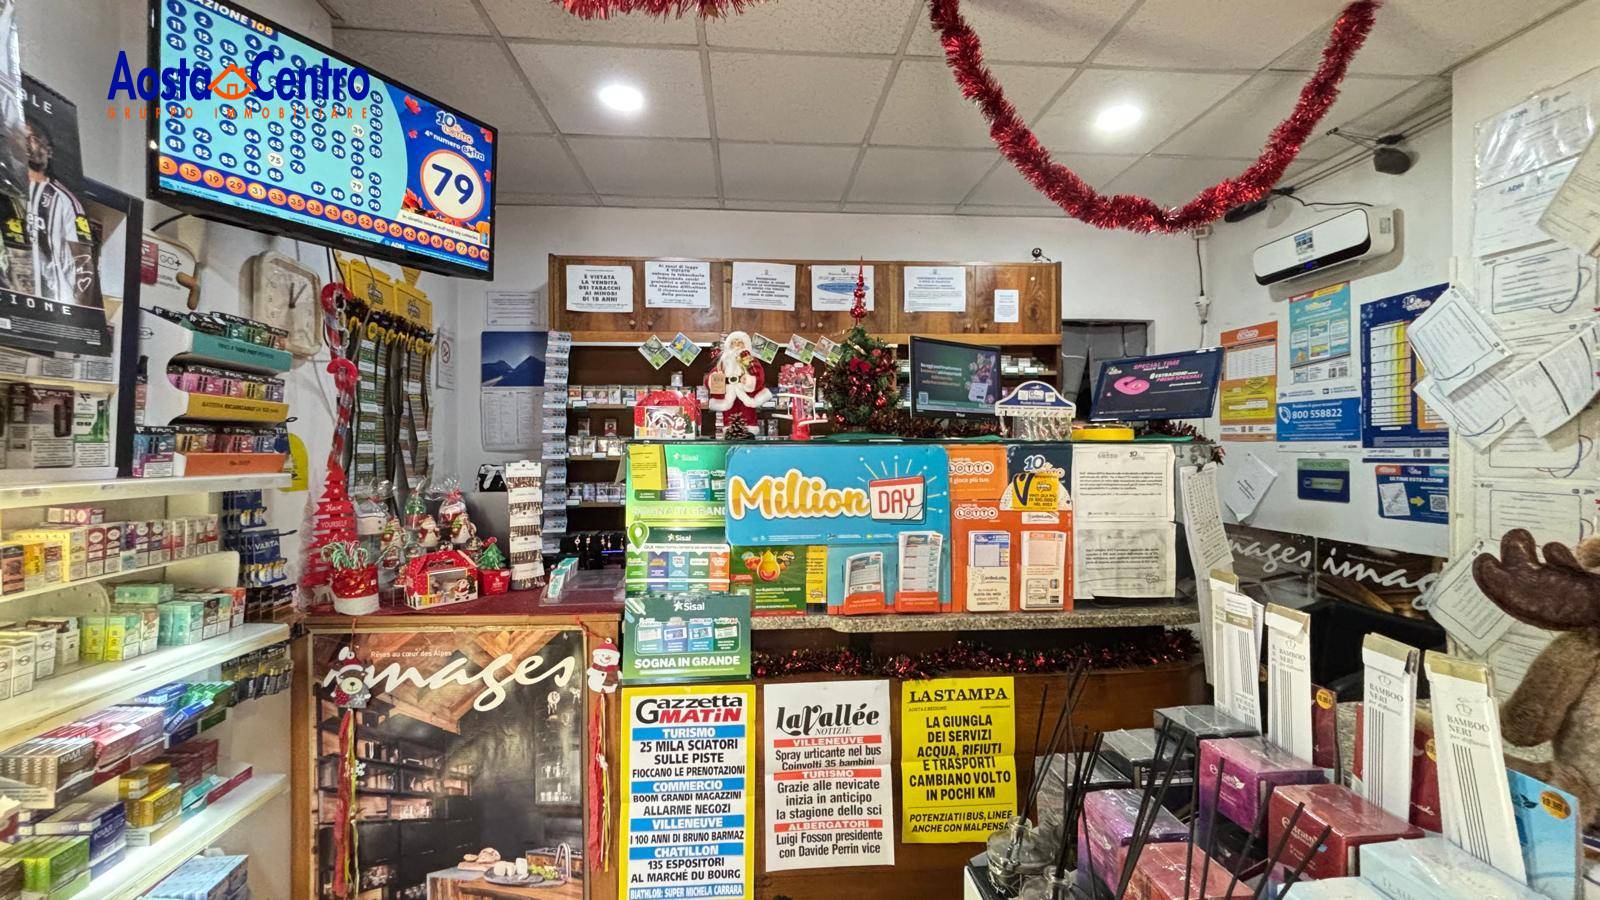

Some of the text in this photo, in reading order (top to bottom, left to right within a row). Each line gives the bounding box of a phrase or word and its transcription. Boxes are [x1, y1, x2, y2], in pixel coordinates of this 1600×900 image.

[201, 0, 273, 35] ZIONE 109
[170, 38, 209, 58] 21 22
[198, 32, 209, 41] 12
[224, 43, 234, 51] 13
[434, 134, 460, 149] numero
[169, 140, 235, 165] 81 82 83
[185, 168, 196, 176] 15
[209, 174, 219, 183] 19
[230, 181, 242, 190] 29
[252, 187, 263, 195] 31
[432, 163, 474, 204] 79
[1292, 409, 1342, 419] 800 558822
[729, 470, 871, 518] Million
[878, 488, 914, 513] DAY
[955, 507, 998, 519] LOTTO
[321, 520, 347, 528] YOURSELF
[255, 541, 279, 550] VARTA
[684, 603, 704, 611] Sisal
[635, 656, 740, 668] SOGNA IN GRANDE
[910, 688, 1007, 702] LA STAMPA
[1369, 683, 1403, 702] BAMBOO
[1369, 692, 1388, 704] NERI
[636, 695, 742, 723] Gazzetta
[926, 715, 992, 728] LA GIUNGLA
[1447, 715, 1490, 732] BAMBOO
[662, 727, 715, 738] TURISMO
[815, 727, 852, 735] NOTIZIE
[928, 729, 991, 743] DEI SERVIZI
[1448, 724, 1472, 737] NERI
[640, 739, 738, 752] 25 MILA SCIATORI
[793, 737, 864, 746] VILLENEUVE
[776, 745, 881, 762] Spray urticante nel bus
[918, 743, 1001, 758] ACQUA, RIFIUTI
[654, 753, 724, 765] SULLE PISTE
[782, 760, 821, 771] Coinvolti
[839, 757, 874, 766] bambini
[923, 756, 995, 771] E TRASPORTI
[633, 765, 745, 778] FIOCCANO LE PRENOTAZIONI
[802, 770, 854, 779] TURISMO
[910, 771, 1011, 787] CAMBIANO VOLTO
[653, 780, 723, 792] COMMERCIO
[777, 779, 879, 793] Grazie alle nevicate
[661, 793, 692, 801] GRANDI
[696, 791, 741, 800] MAGAZZINI
[786, 792, 872, 806] inizia in anticipo
[927, 786, 995, 801] IN POCHI KM
[644, 804, 730, 816] ALLARME NEGOZI
[776, 804, 882, 820] la stagione dello sci
[653, 818, 723, 829] VILLENEUVE
[910, 813, 962, 822] POTENZIATI
[967, 812, 986, 821] BUS,
[788, 821, 869, 830] ALBERGATORI
[912, 824, 943, 833] ANCHE
[944, 824, 962, 832] CON
[630, 831, 744, 844] I 100 ANNI DI BRUNO BARMAZ
[776, 830, 882, 846] Luigi Fosson presidente
[654, 845, 718, 857] CHATILLON
[779, 842, 880, 858] con Davide Perrin vice
[648, 857, 724, 869] 135 ESPOSITORI
[631, 869, 740, 883] AL MARCHÉ DU BOURG
[630, 885, 742, 899] BIATHLON: SUPER MICHELA CARRARA
